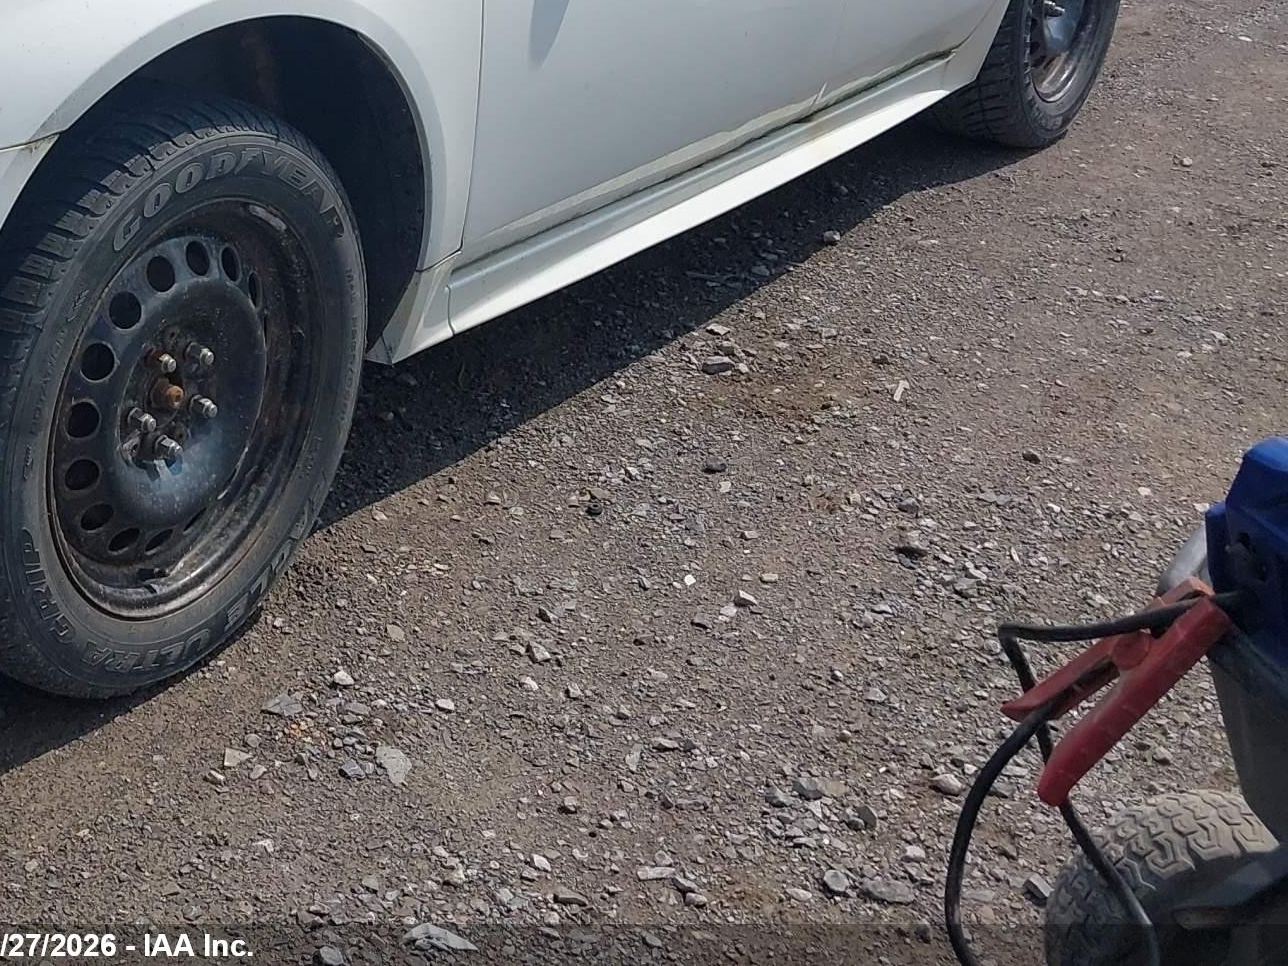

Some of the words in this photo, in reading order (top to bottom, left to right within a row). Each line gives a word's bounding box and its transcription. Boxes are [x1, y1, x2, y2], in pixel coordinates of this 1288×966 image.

[112, 147, 346, 251] GOODYEAR
[22, 527, 76, 643] GRIP
[81, 628, 211, 674] ULTRA
